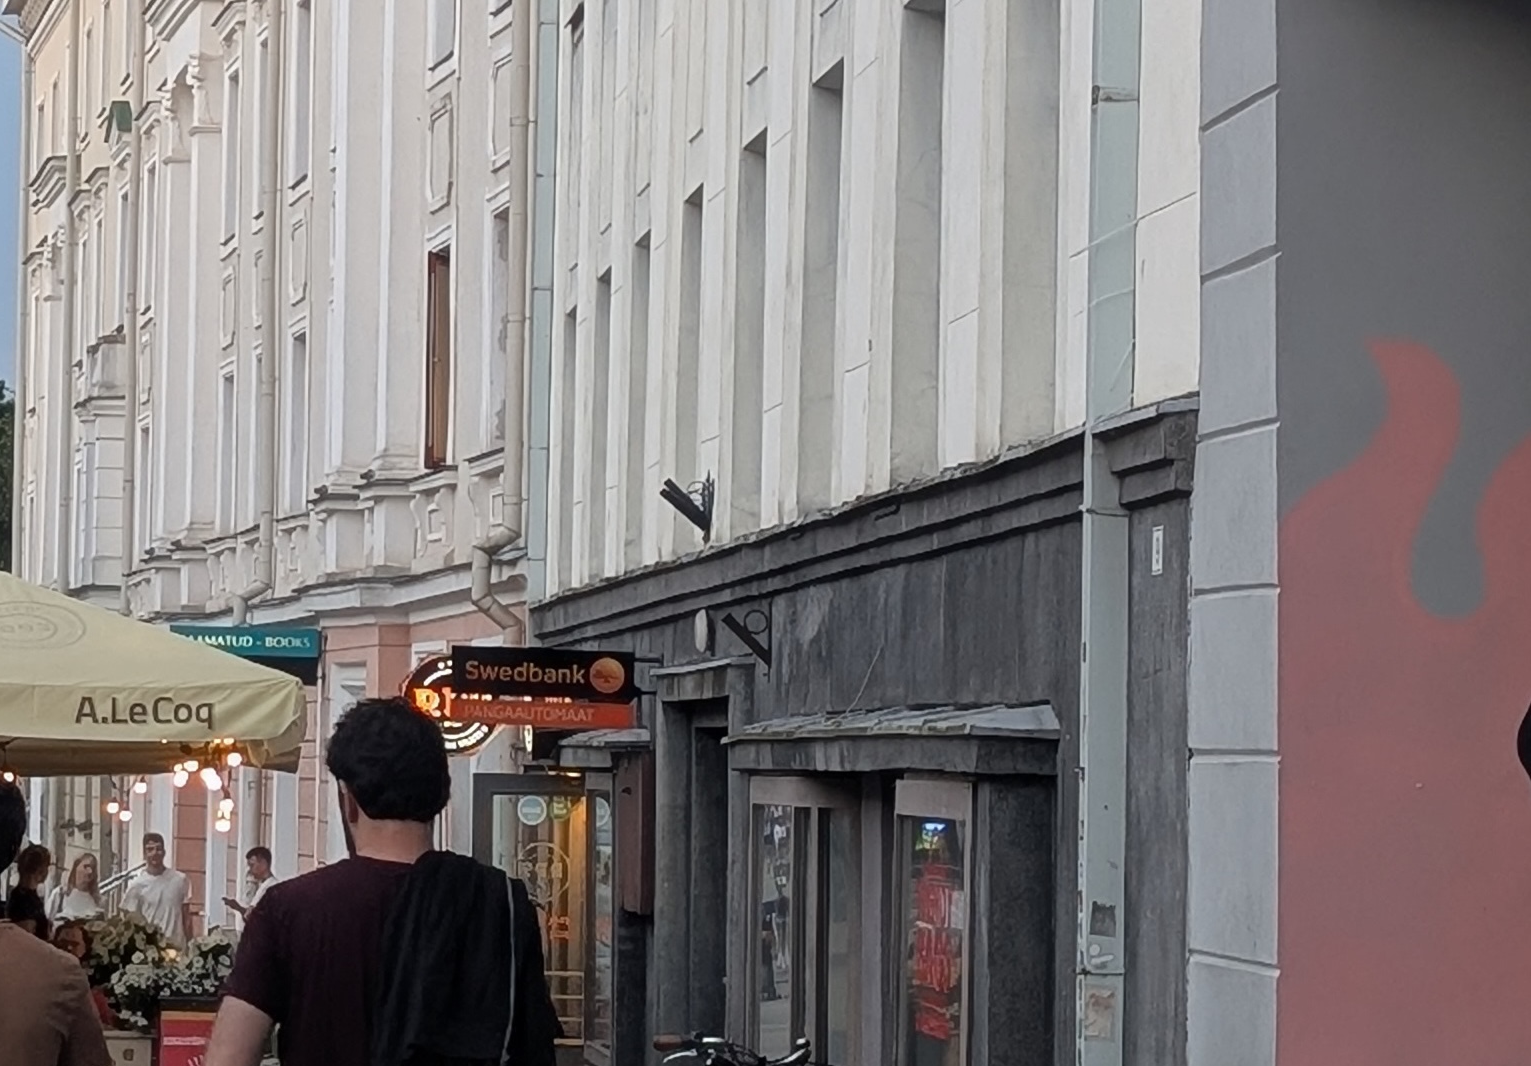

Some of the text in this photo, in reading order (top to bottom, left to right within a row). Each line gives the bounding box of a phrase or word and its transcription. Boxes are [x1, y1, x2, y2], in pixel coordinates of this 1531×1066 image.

[264, 636, 311, 648] BOOKS
[465, 660, 587, 684] Swedbank
[463, 703, 595, 721] PANGAAUTOMAAT
